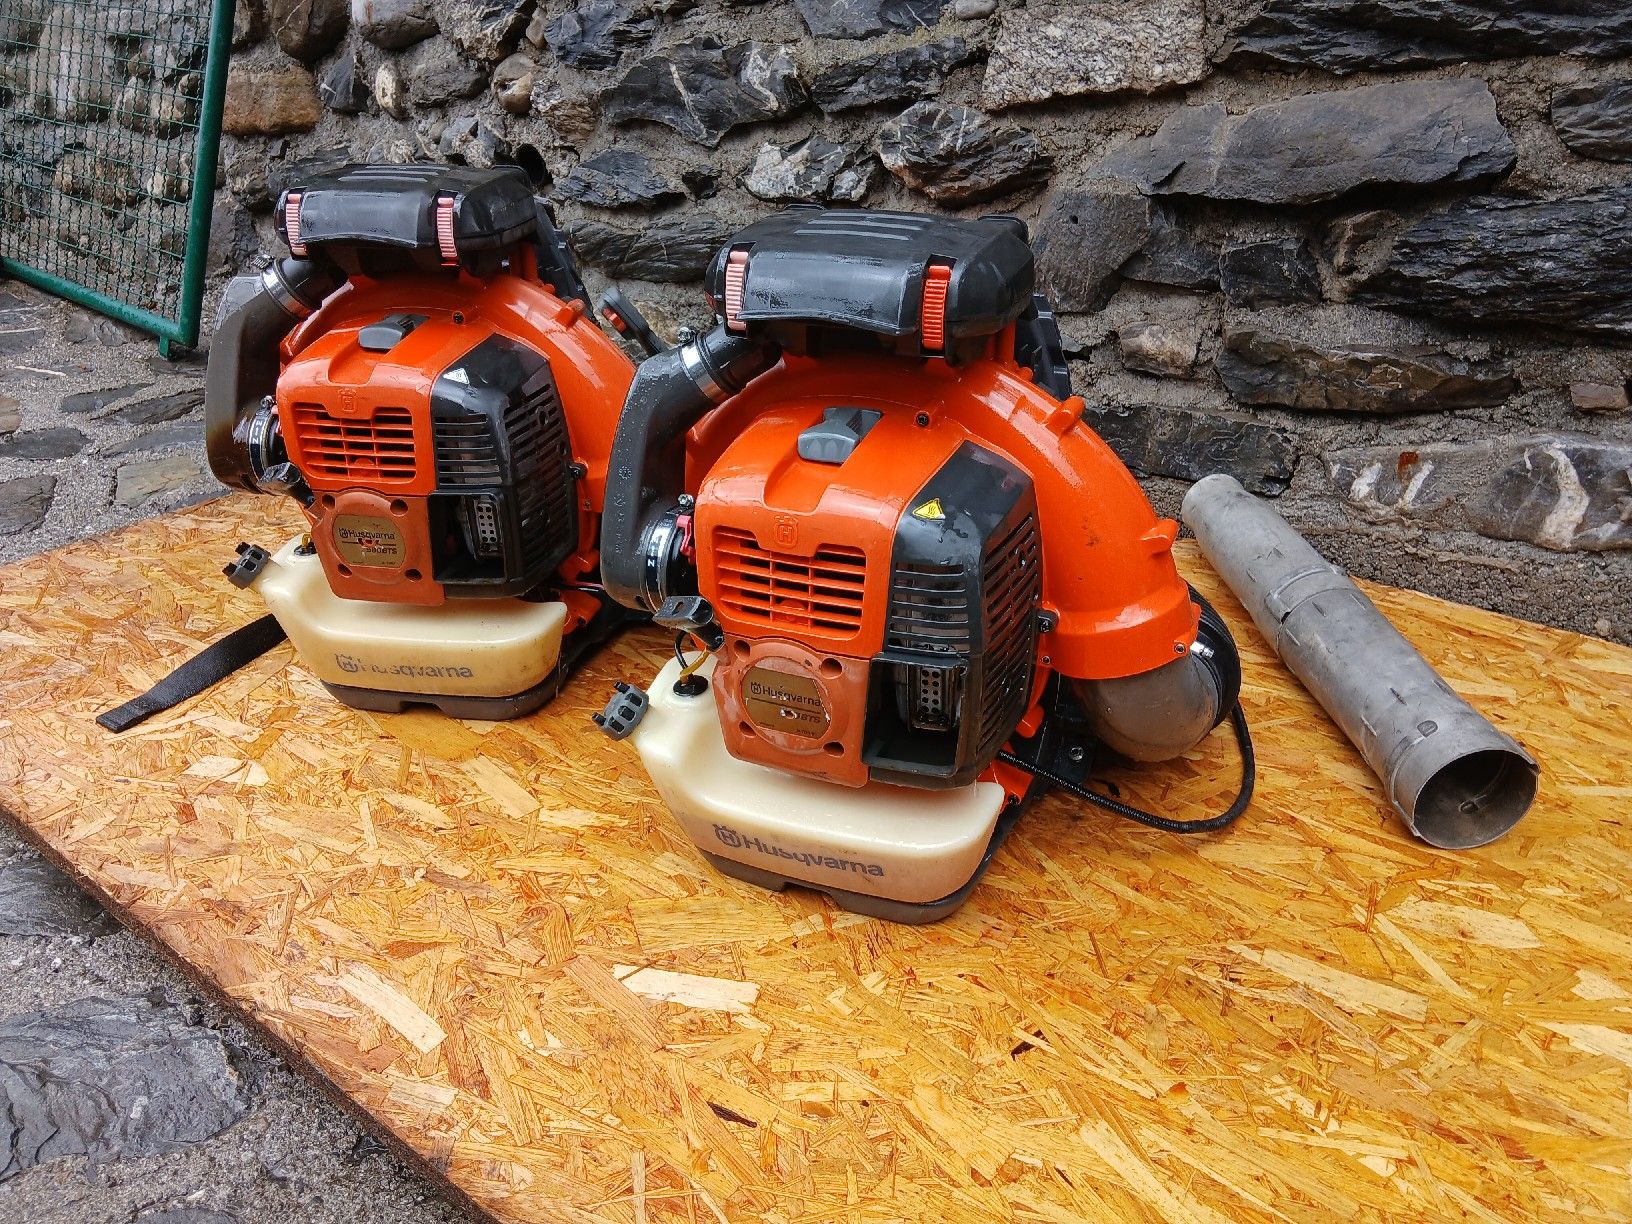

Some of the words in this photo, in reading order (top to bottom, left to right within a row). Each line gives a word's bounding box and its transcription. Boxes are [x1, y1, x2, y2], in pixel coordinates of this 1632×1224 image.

[348, 529, 395, 540] Husqvarna
[763, 685, 821, 706] Husqvarna
[742, 834, 884, 877] Husqvarna
